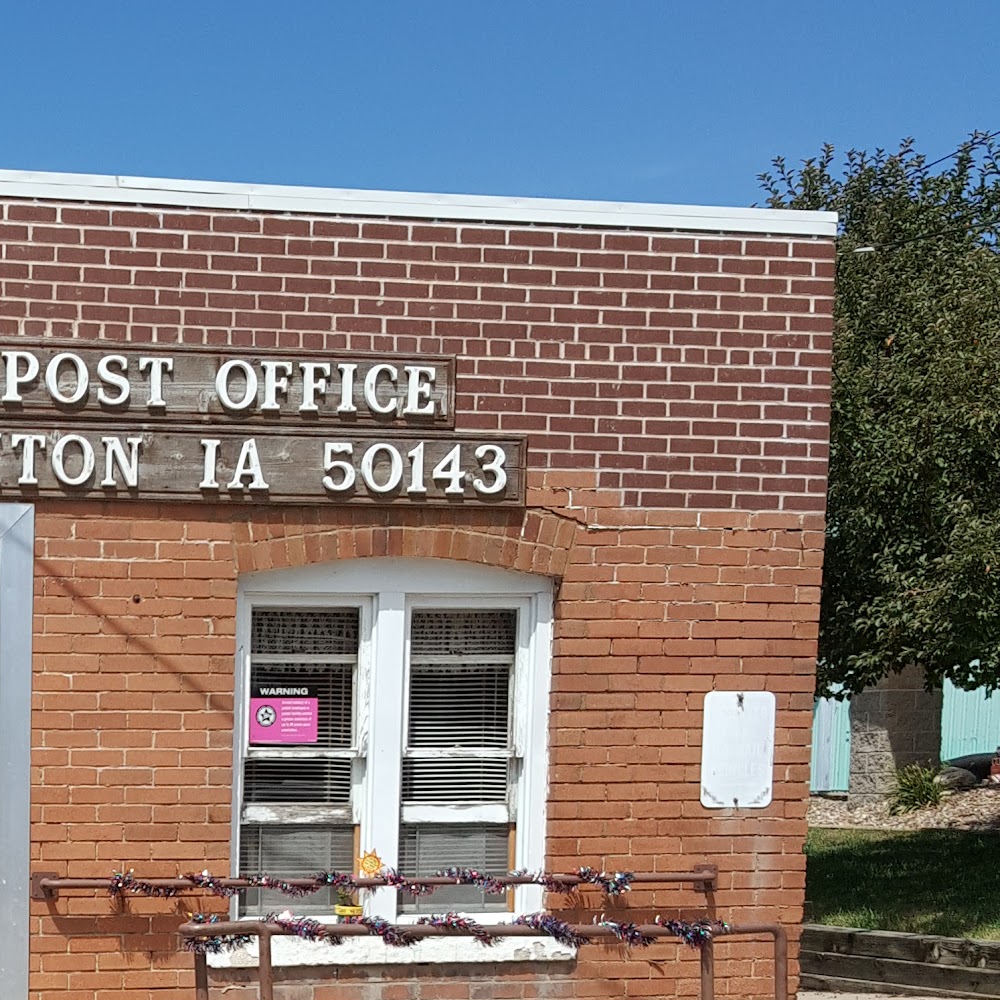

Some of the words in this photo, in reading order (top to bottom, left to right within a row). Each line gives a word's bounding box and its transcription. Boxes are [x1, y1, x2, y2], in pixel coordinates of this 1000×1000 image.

[1, 351, 174, 407] POST
[215, 359, 436, 415] OFFICE
[199, 438, 270, 489] IA
[322, 441, 508, 494] 50143
[259, 687, 309, 695] WARNING
